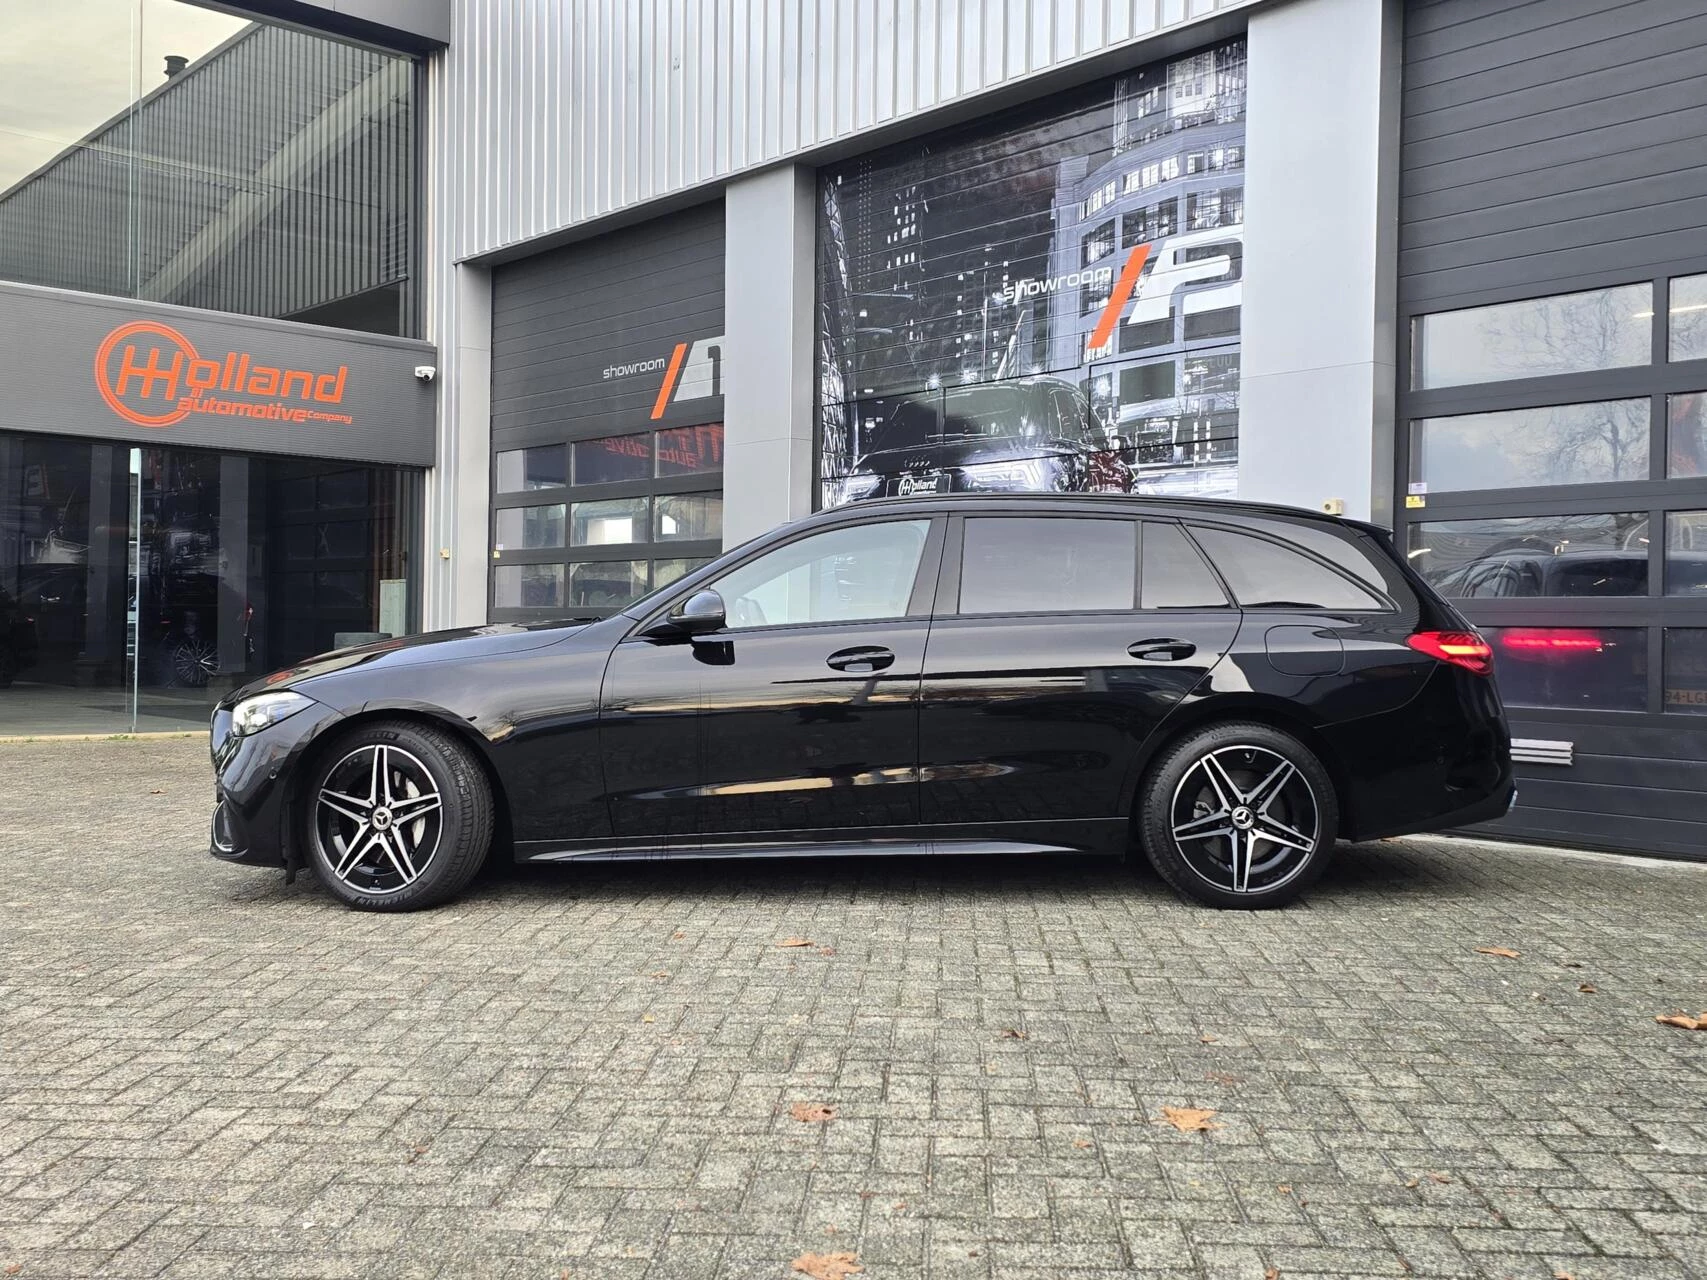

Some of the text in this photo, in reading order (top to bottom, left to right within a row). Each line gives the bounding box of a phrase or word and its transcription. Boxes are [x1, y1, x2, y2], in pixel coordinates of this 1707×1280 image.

[1003, 266, 1112, 299] showroom
[603, 358, 665, 379] showroom
[176, 397, 352, 424] automotive Company
